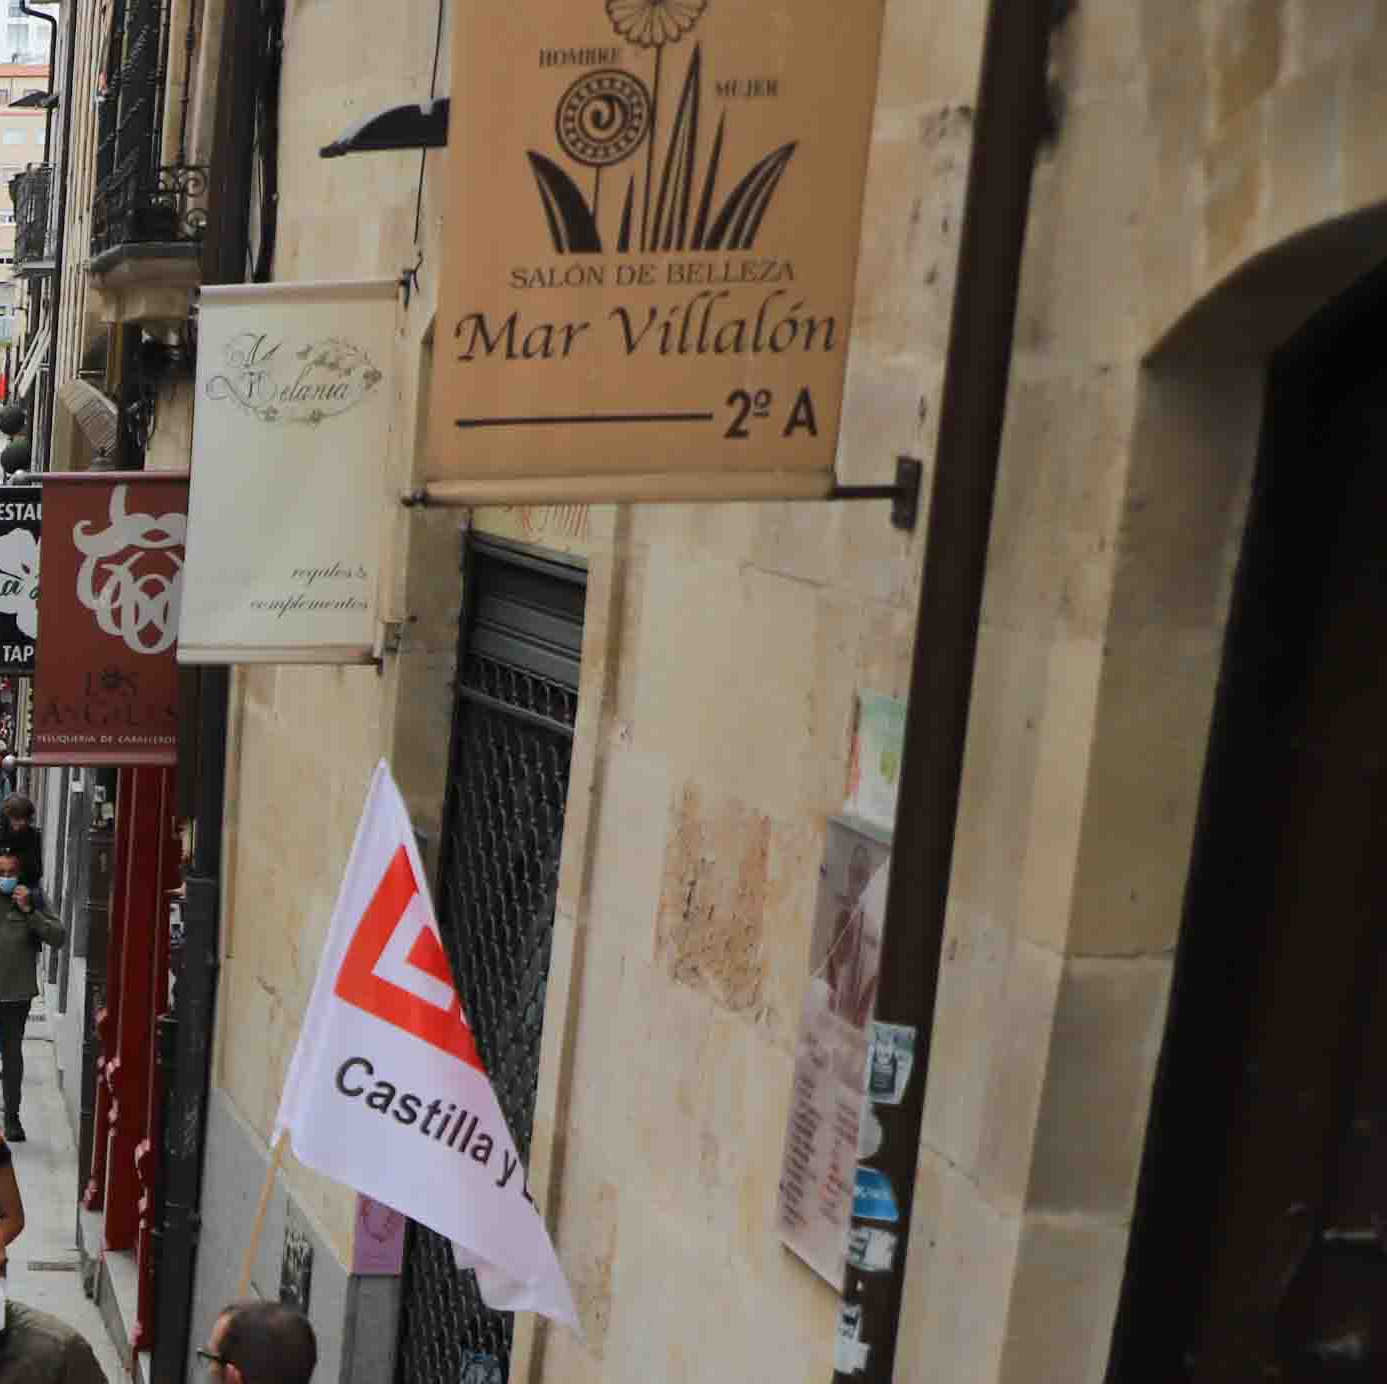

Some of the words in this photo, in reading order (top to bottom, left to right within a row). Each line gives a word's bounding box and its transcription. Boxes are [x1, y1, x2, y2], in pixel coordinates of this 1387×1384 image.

[539, 48, 623, 69] HOMBRE
[715, 79, 779, 97] MUJER
[508, 262, 605, 290] SALÓN
[616, 263, 656, 286] DE
[667, 259, 796, 284] BELLEZA
[453, 309, 590, 362] Mar
[608, 289, 838, 357] Villalón
[781, 386, 819, 437] A
[334, 1056, 494, 1166] Castilla
[495, 1148, 518, 1188] y
